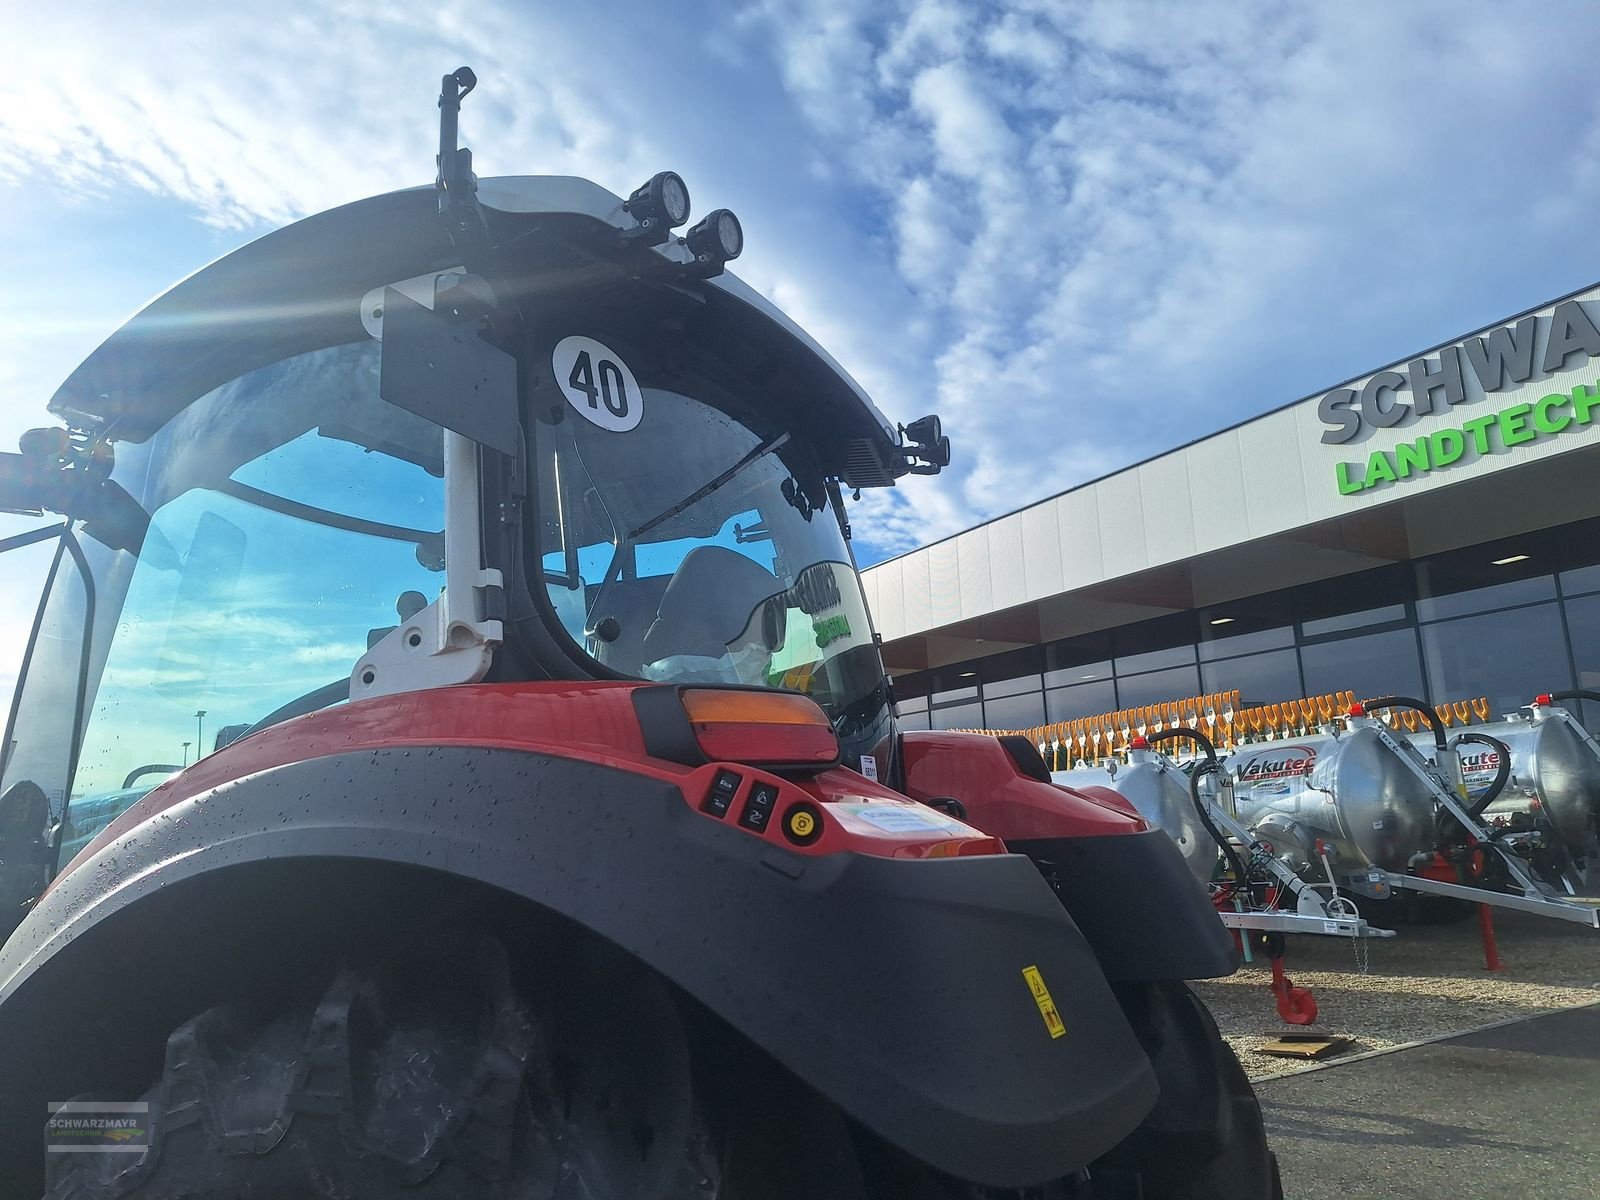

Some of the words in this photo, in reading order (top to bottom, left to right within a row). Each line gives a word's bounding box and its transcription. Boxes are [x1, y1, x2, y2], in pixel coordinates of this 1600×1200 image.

[569, 350, 628, 418] 40
[1318, 300, 1600, 444] SCHWA
[1336, 379, 1600, 496] LANDTECH
[1237, 757, 1316, 782] Vakutec
[1460, 752, 1499, 767] kute
